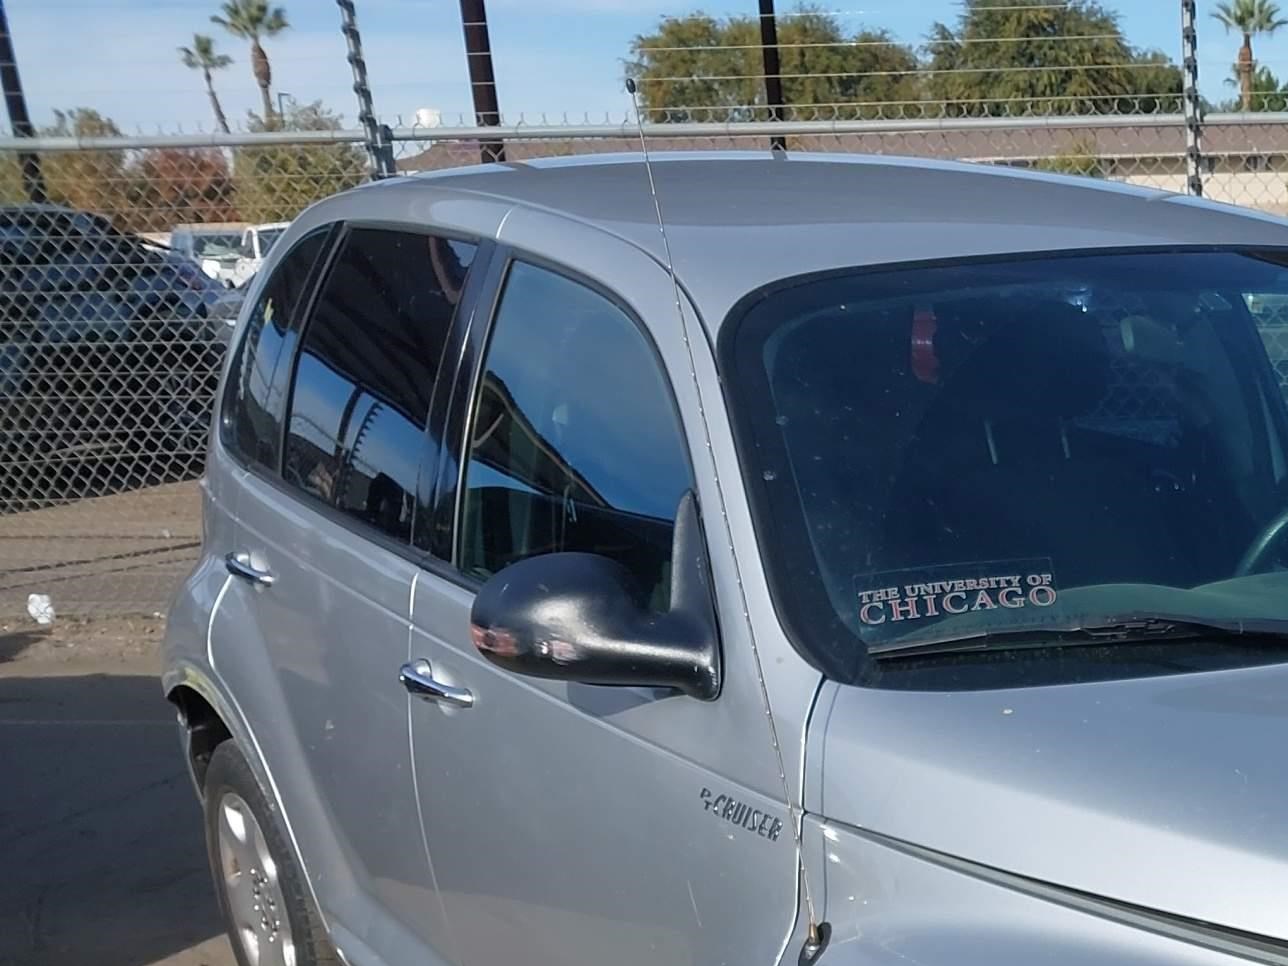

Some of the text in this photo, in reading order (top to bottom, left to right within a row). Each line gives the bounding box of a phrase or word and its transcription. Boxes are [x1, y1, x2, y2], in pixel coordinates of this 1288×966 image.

[858, 574, 1053, 605] THE UNIVERSITY OF
[858, 585, 1058, 626] CHICAGO
[713, 793, 784, 843] CRUISER
